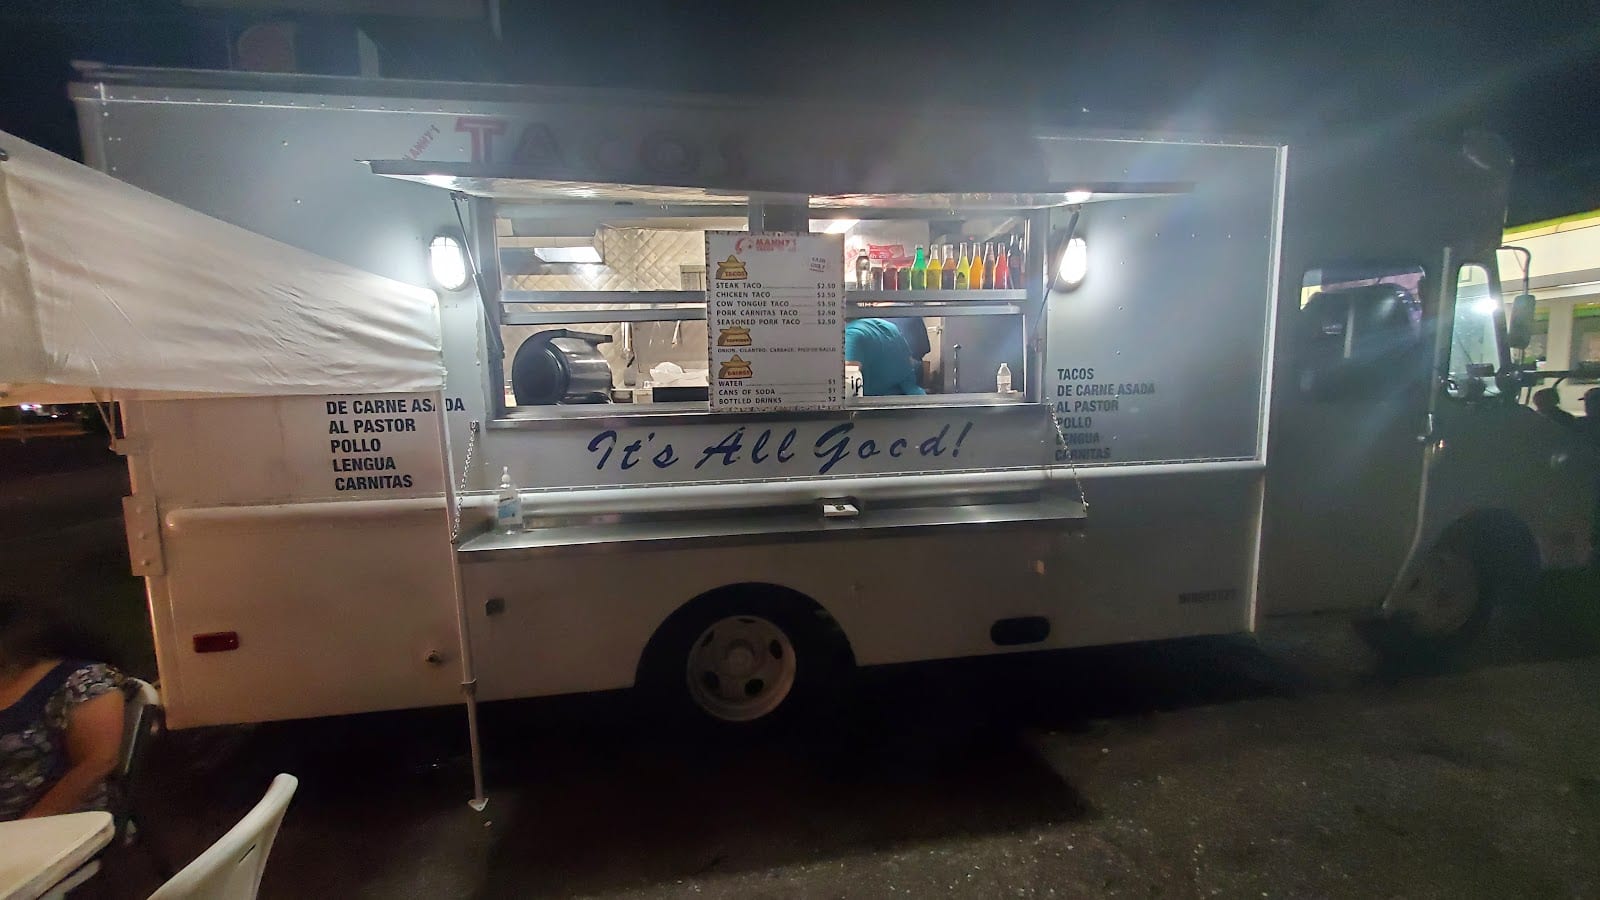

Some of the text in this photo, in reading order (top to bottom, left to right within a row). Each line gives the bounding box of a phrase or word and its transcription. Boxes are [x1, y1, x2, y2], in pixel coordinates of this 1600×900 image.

[1057, 368, 1094, 380] TACOS
[845, 376, 863, 396] ip
[1057, 382, 1155, 397] DE CARNE ASADA
[326, 400, 348, 415] DE
[353, 399, 407, 414] CARNE
[1056, 400, 1119, 413] AL PASTOR
[329, 418, 416, 434] AL PASTOR
[1057, 416, 1092, 429] POLLO
[331, 438, 381, 453] POLLO
[587, 421, 973, 475] It's All Good!
[332, 456, 396, 472] LENGUA
[335, 475, 413, 490] CARNITAS
